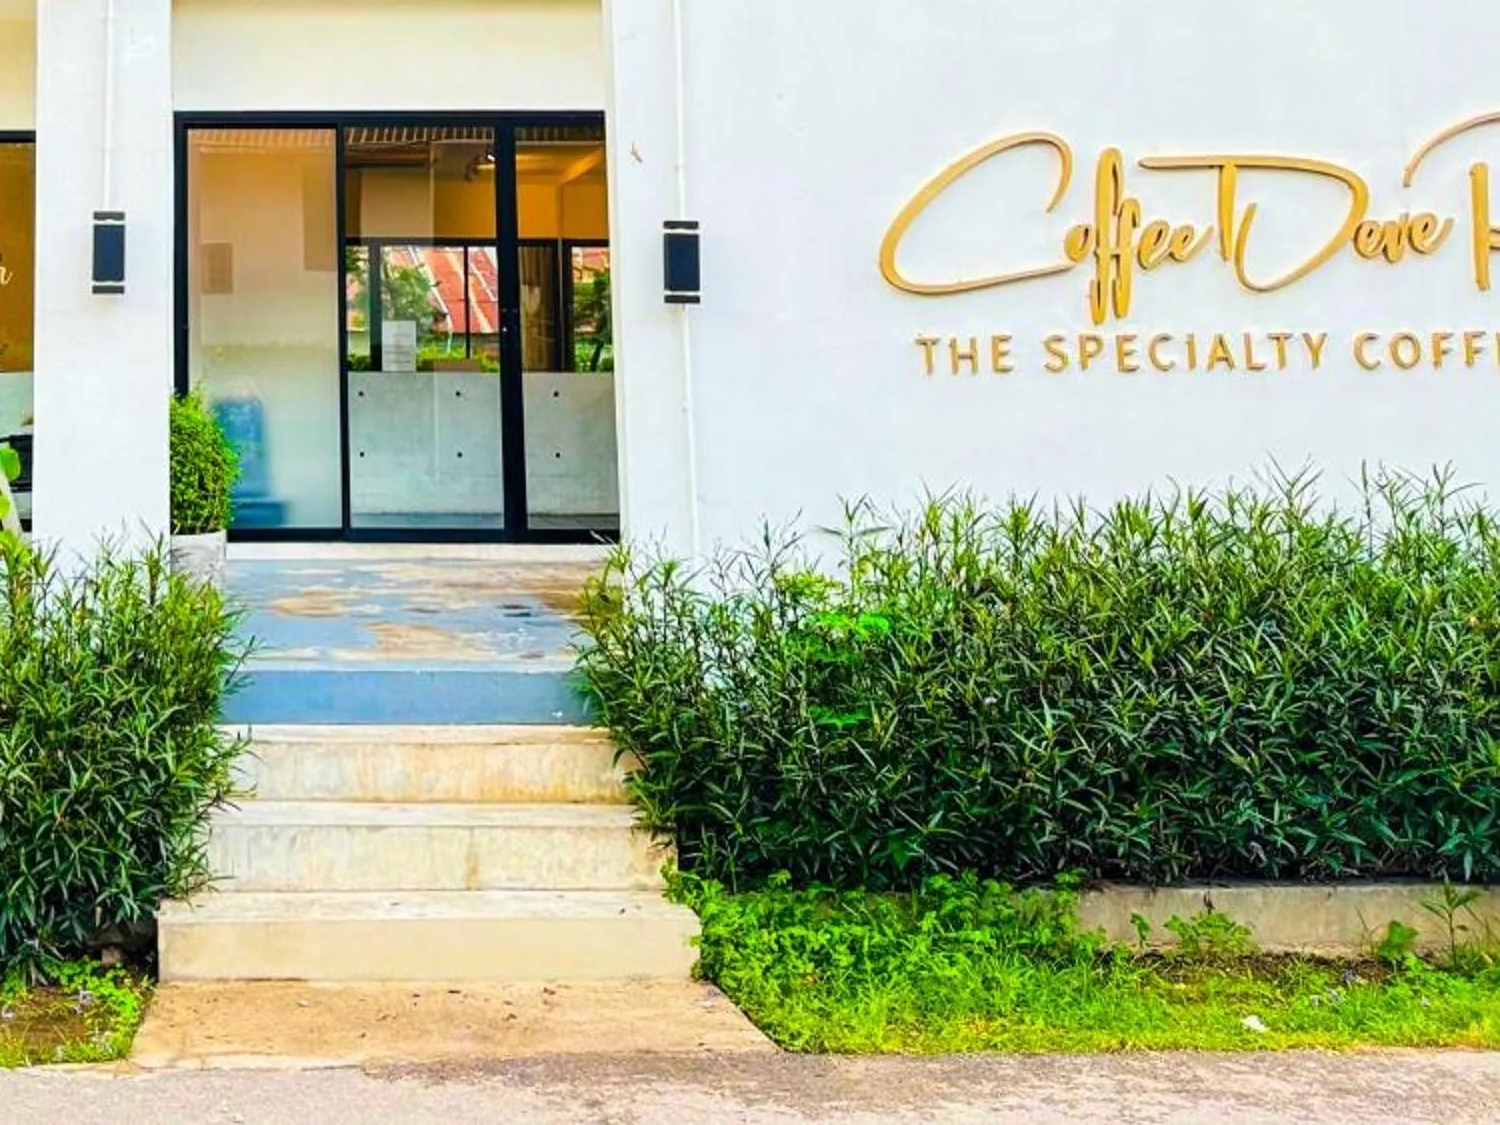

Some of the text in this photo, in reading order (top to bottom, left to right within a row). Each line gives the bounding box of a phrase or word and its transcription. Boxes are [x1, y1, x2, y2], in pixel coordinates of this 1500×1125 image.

[878, 130, 1213, 325] Coffee
[915, 330, 1500, 374] THE SPECIALTY COFF
